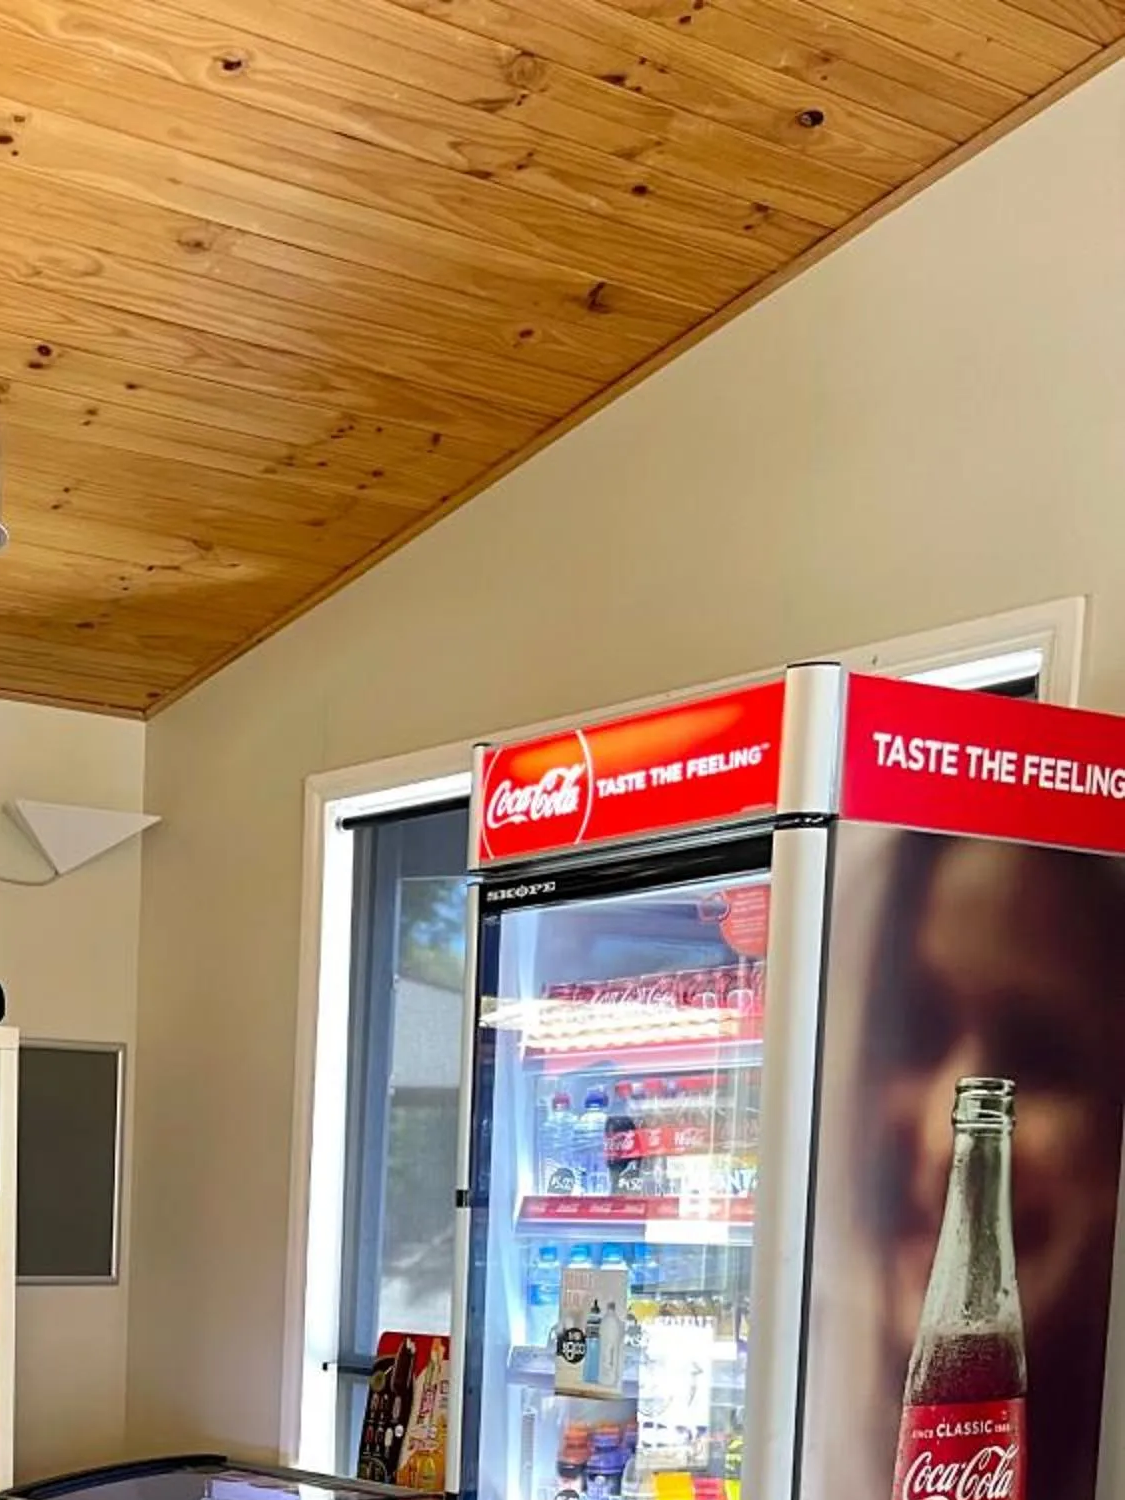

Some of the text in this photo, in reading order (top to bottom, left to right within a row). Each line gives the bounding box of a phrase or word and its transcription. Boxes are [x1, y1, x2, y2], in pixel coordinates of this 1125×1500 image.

[873, 732, 1125, 799] TASTE THE FEELING
[596, 771, 646, 798] TASTE
[650, 765, 681, 787] THE
[486, 881, 557, 901] SKOPE
[936, 1419, 993, 1438] CLASSIC
